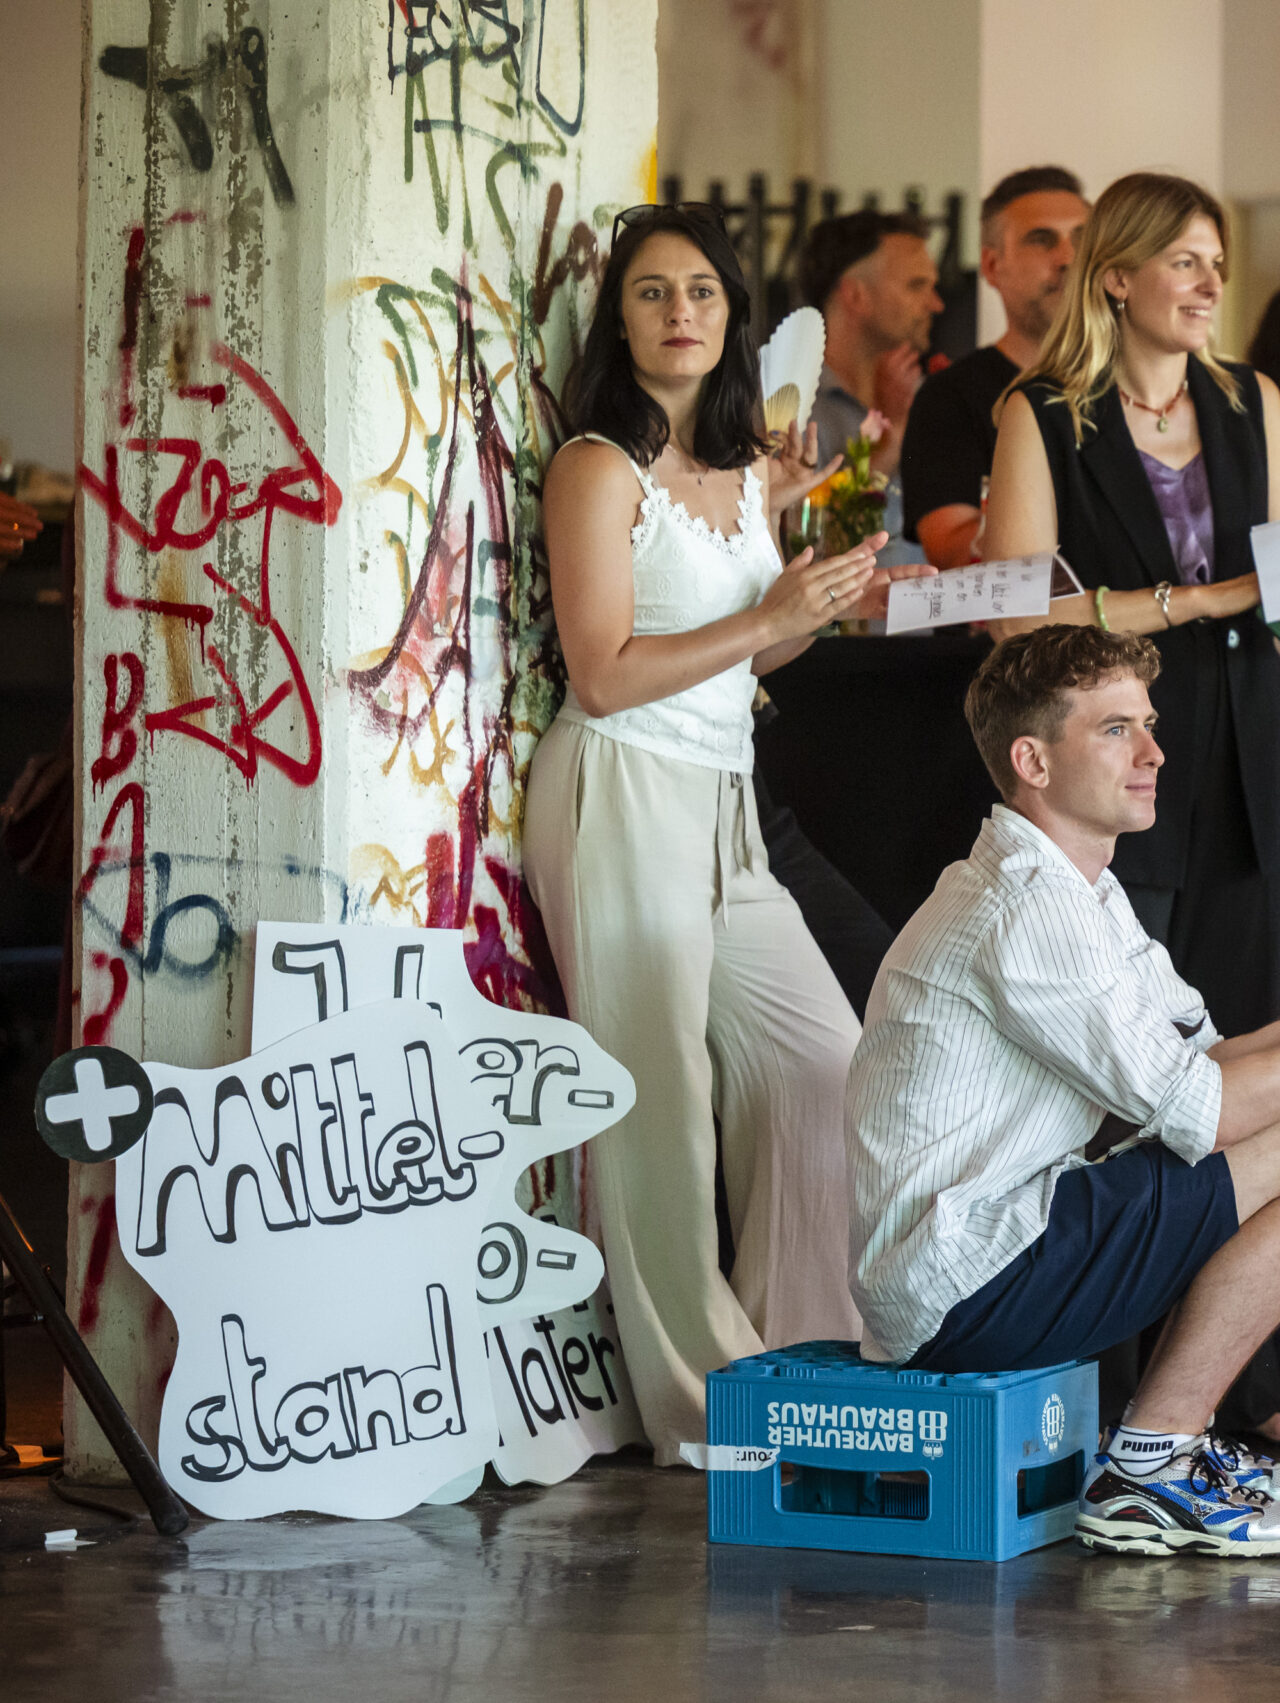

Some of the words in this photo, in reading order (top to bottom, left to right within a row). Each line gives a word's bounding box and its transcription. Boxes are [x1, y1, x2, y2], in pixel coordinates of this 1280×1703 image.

[135, 1039, 505, 1257] Mittel-
[180, 1283, 467, 1483] stand
[484, 1314, 616, 1446] later
[767, 1401, 914, 1431] BRAUHAUS
[767, 1424, 914, 1453] BAYREUTHER
[1120, 1440, 1174, 1453] PUMA
